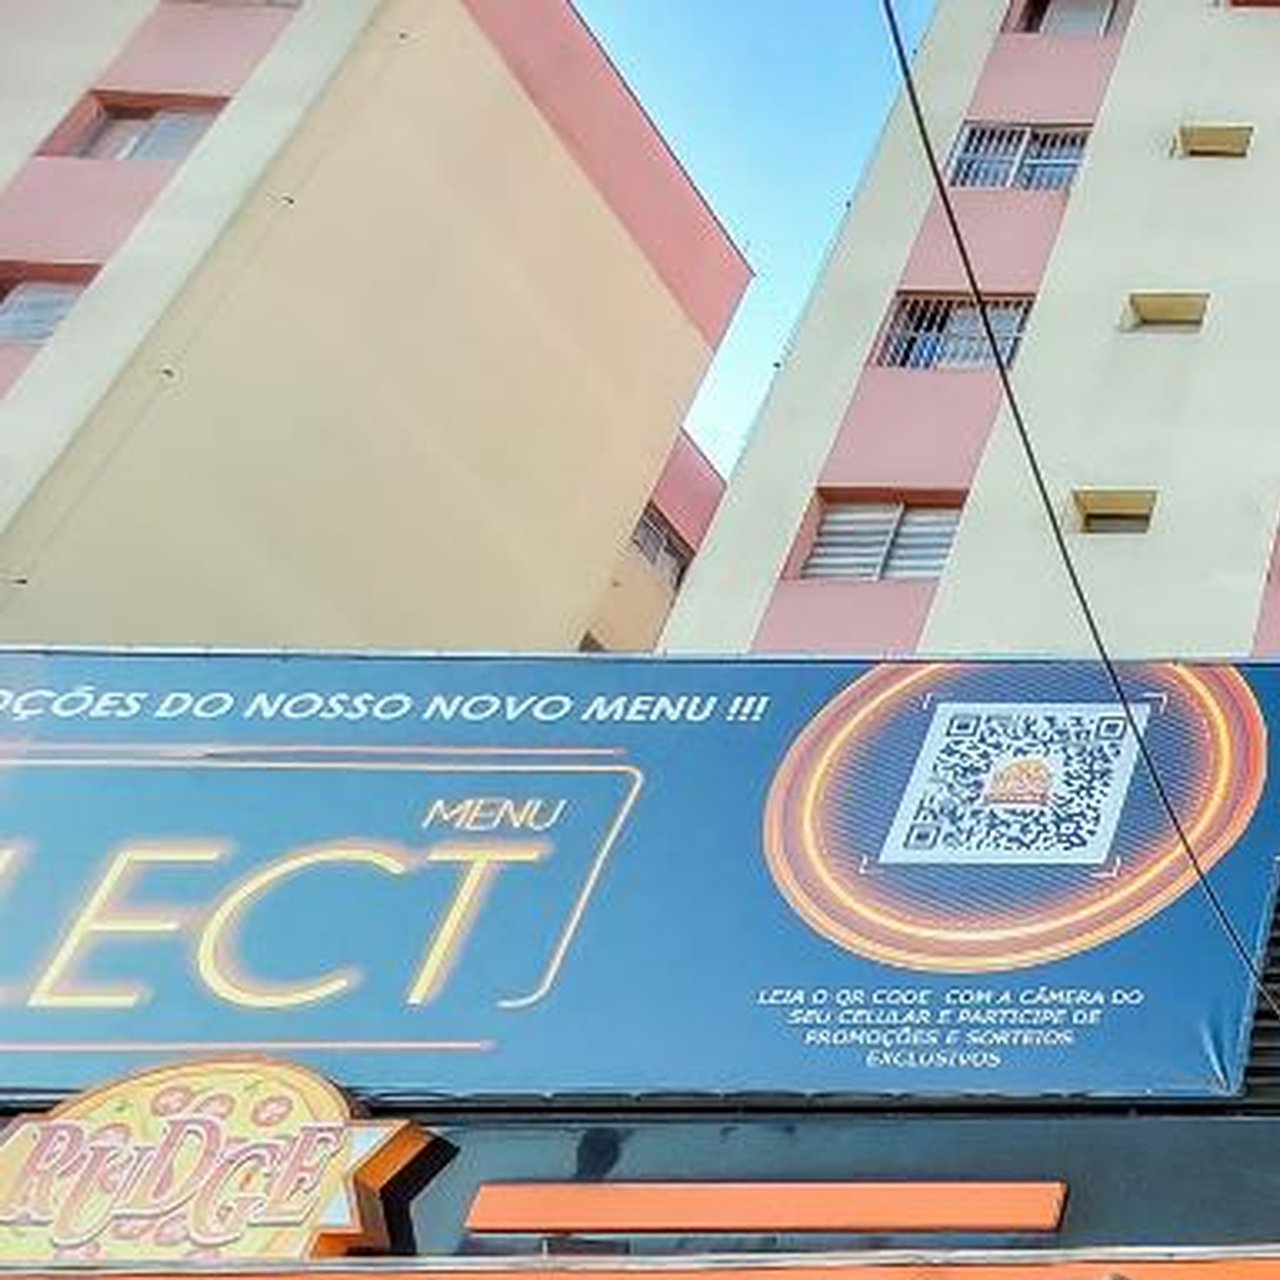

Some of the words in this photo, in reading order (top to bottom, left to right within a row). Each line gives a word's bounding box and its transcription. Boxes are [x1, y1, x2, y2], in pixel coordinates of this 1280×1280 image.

[155, 692, 234, 718] DO
[244, 692, 410, 719] NOSSO
[423, 694, 573, 721] NOVO
[580, 695, 716, 722] MENU
[724, 695, 770, 722] !!!
[422, 798, 568, 831] MENU
[0, 843, 552, 1007] ECT
[757, 989, 805, 1005] LEIA
[812, 989, 828, 1005] O
[836, 989, 865, 1006] QR
[872, 989, 932, 1005] CODE
[945, 989, 990, 1005] COM
[995, 989, 1012, 1005] A
[1019, 985, 1105, 1005] CÂMERA
[1111, 988, 1144, 1005] DO
[788, 1009, 831, 1025] SEU
[838, 1009, 931, 1025] CELULAR
[957, 1009, 1067, 1025] PARTICIPE
[1072, 1009, 1103, 1025] DE
[804, 1026, 940, 1047] PROMOÇÕES
[965, 1029, 1074, 1046] SORTEIOS
[865, 1050, 1002, 1069] EXCLUSIVOS
